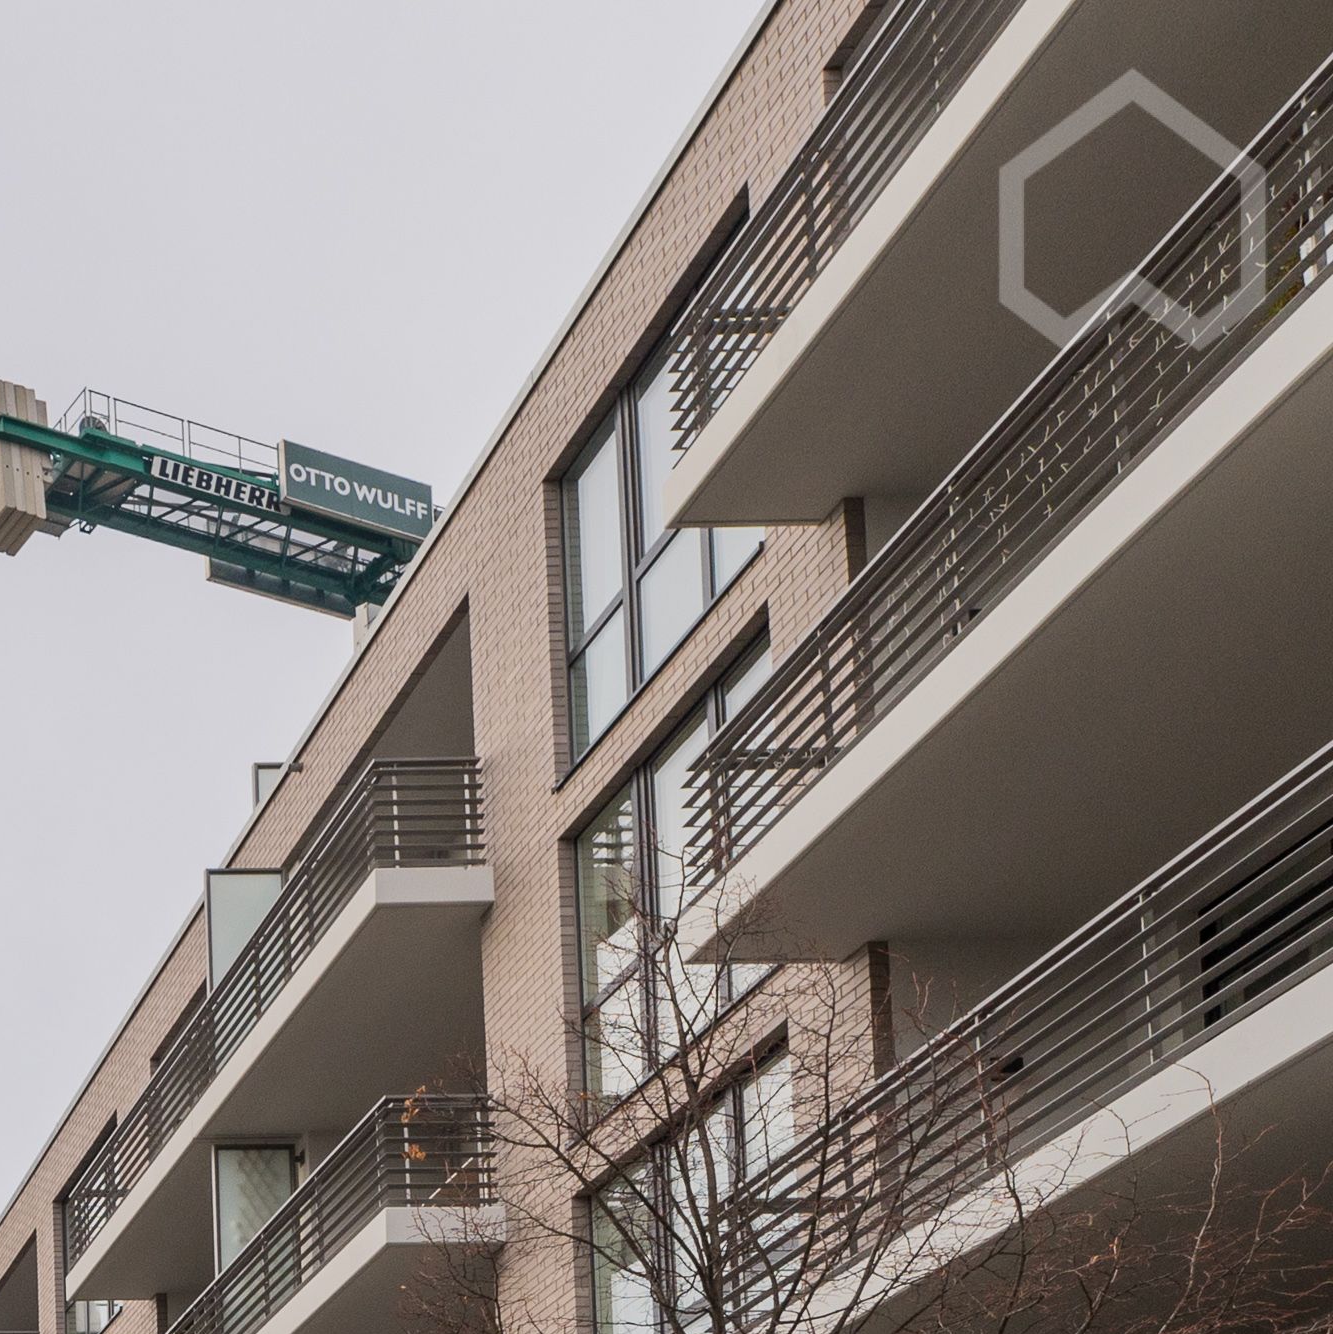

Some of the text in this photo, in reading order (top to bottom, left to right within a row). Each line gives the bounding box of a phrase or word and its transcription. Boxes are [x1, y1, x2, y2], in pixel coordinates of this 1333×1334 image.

[158, 459, 281, 513] LIEBHERR
[289, 463, 428, 520] OTTO WULFF
